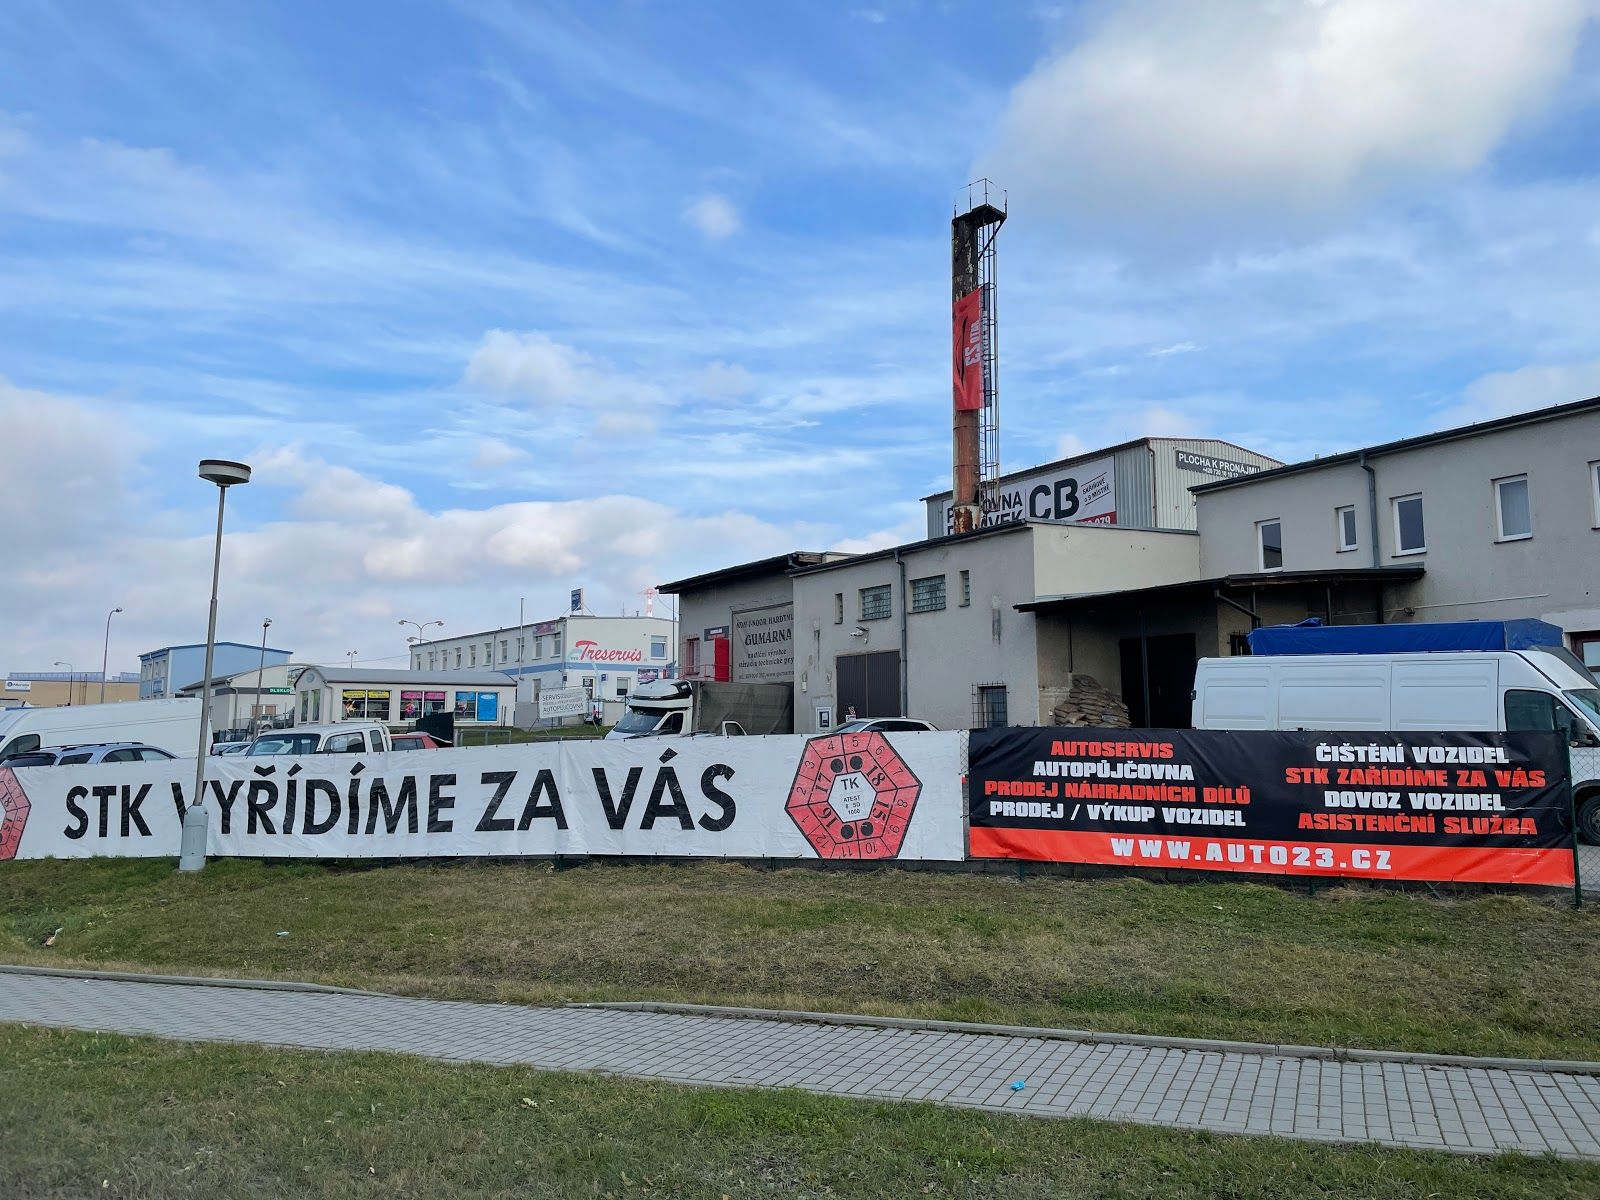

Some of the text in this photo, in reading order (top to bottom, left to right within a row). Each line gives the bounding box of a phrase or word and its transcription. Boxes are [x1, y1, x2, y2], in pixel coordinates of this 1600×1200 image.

[1178, 453, 1210, 467] PLOCHA
[1212, 460, 1218, 469] K
[1029, 478, 1080, 519] CB
[745, 627, 792, 646] GUMÁRNA
[575, 640, 642, 662] Treservis
[542, 693, 561, 701] SERVIS
[828, 741, 835, 751] 4
[852, 736, 859, 748] 5
[1050, 741, 1174, 759] AUTOSERVIS
[1315, 742, 1510, 764] ČIŠTĚNÍ VOZIDEL
[805, 760, 815, 769] 3
[892, 766, 904, 776] 7
[1032, 760, 1195, 780] AUTOPŮJČOVNA
[815, 772, 832, 794] 17
[841, 777, 860, 791] TK
[866, 764, 886, 787] 18
[1285, 766, 1546, 788] STK ZAŘÍDÍME ZA VÁS
[1, 792, 12, 807] 18
[63, 747, 737, 840] STK VYŘÍDÍME ZA VÁS
[796, 786, 807, 796] 2
[984, 780, 1251, 805] PRODEJ NÁHRADNÍCH DÍLŮ
[1324, 790, 1506, 811] DOVOZ VOZIDEL
[872, 799, 890, 822] 15
[897, 798, 908, 808] 8
[818, 807, 838, 828] 16
[989, 801, 1247, 827] PRODEJ / VÝKUP VOZIDEL
[1298, 812, 1538, 835] ASISTENČNÍ SLUŽBA
[865, 842, 878, 855] 10
[1110, 838, 1392, 870] WWW.AUTO23.CZ
